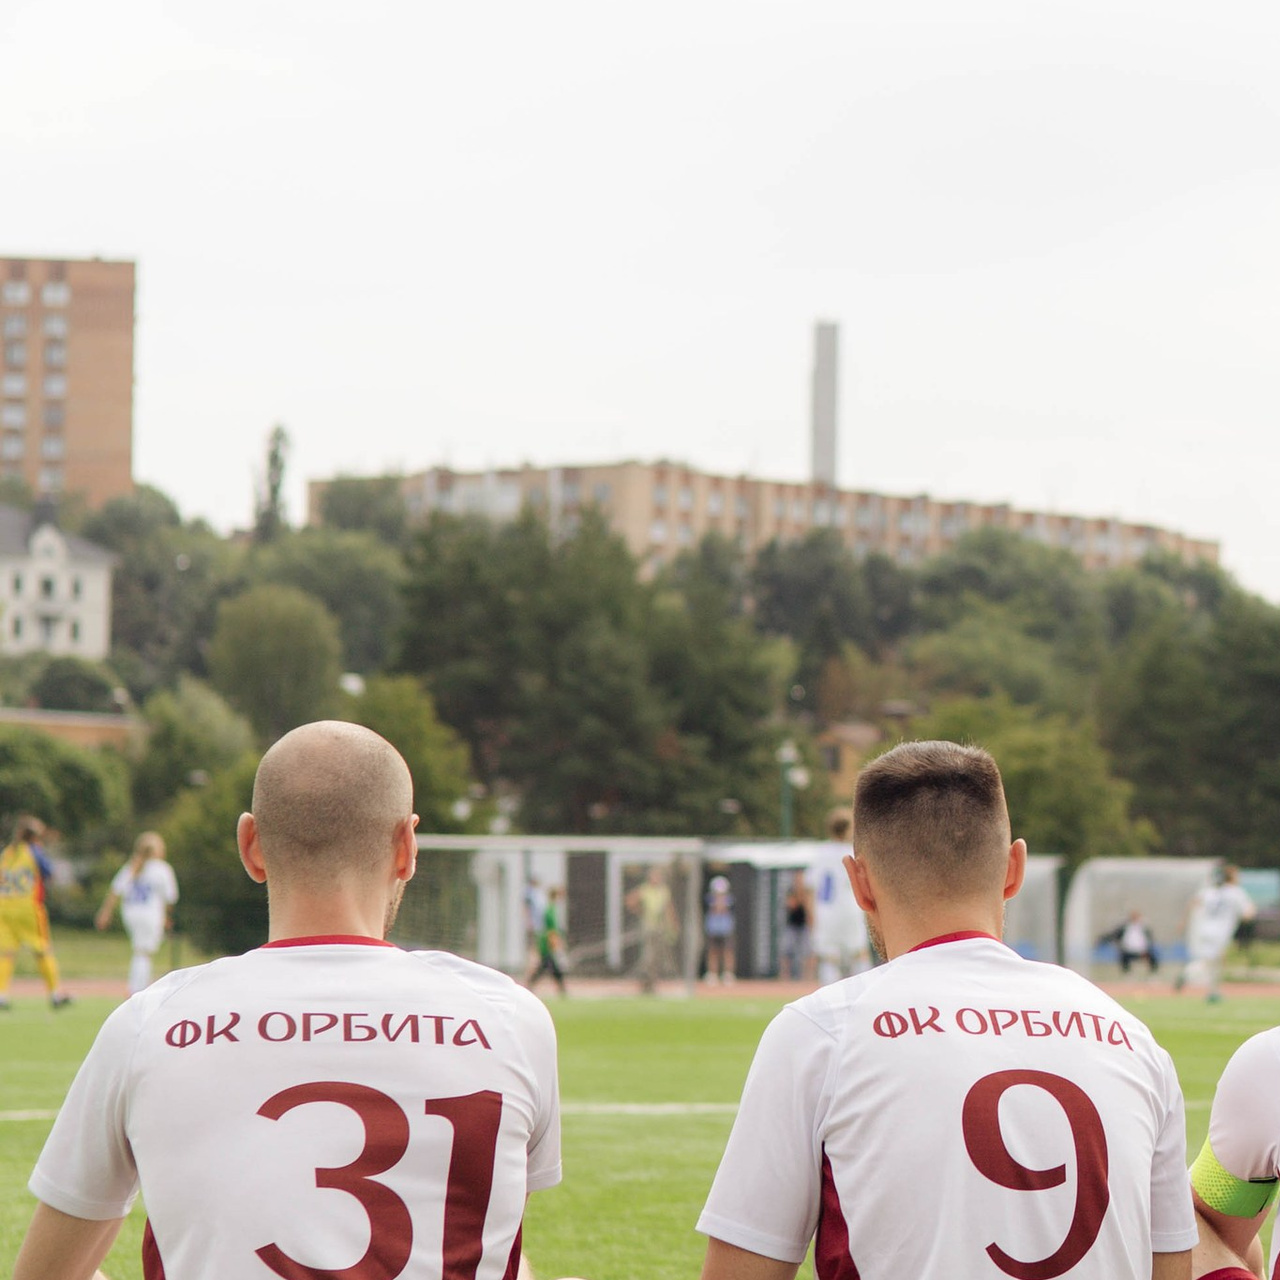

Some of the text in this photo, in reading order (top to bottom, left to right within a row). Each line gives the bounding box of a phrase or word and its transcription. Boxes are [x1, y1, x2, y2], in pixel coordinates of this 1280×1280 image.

[165, 1012, 492, 1050] ФК ОРБИТА
[873, 1007, 1133, 1051] ФК ОРБИТА
